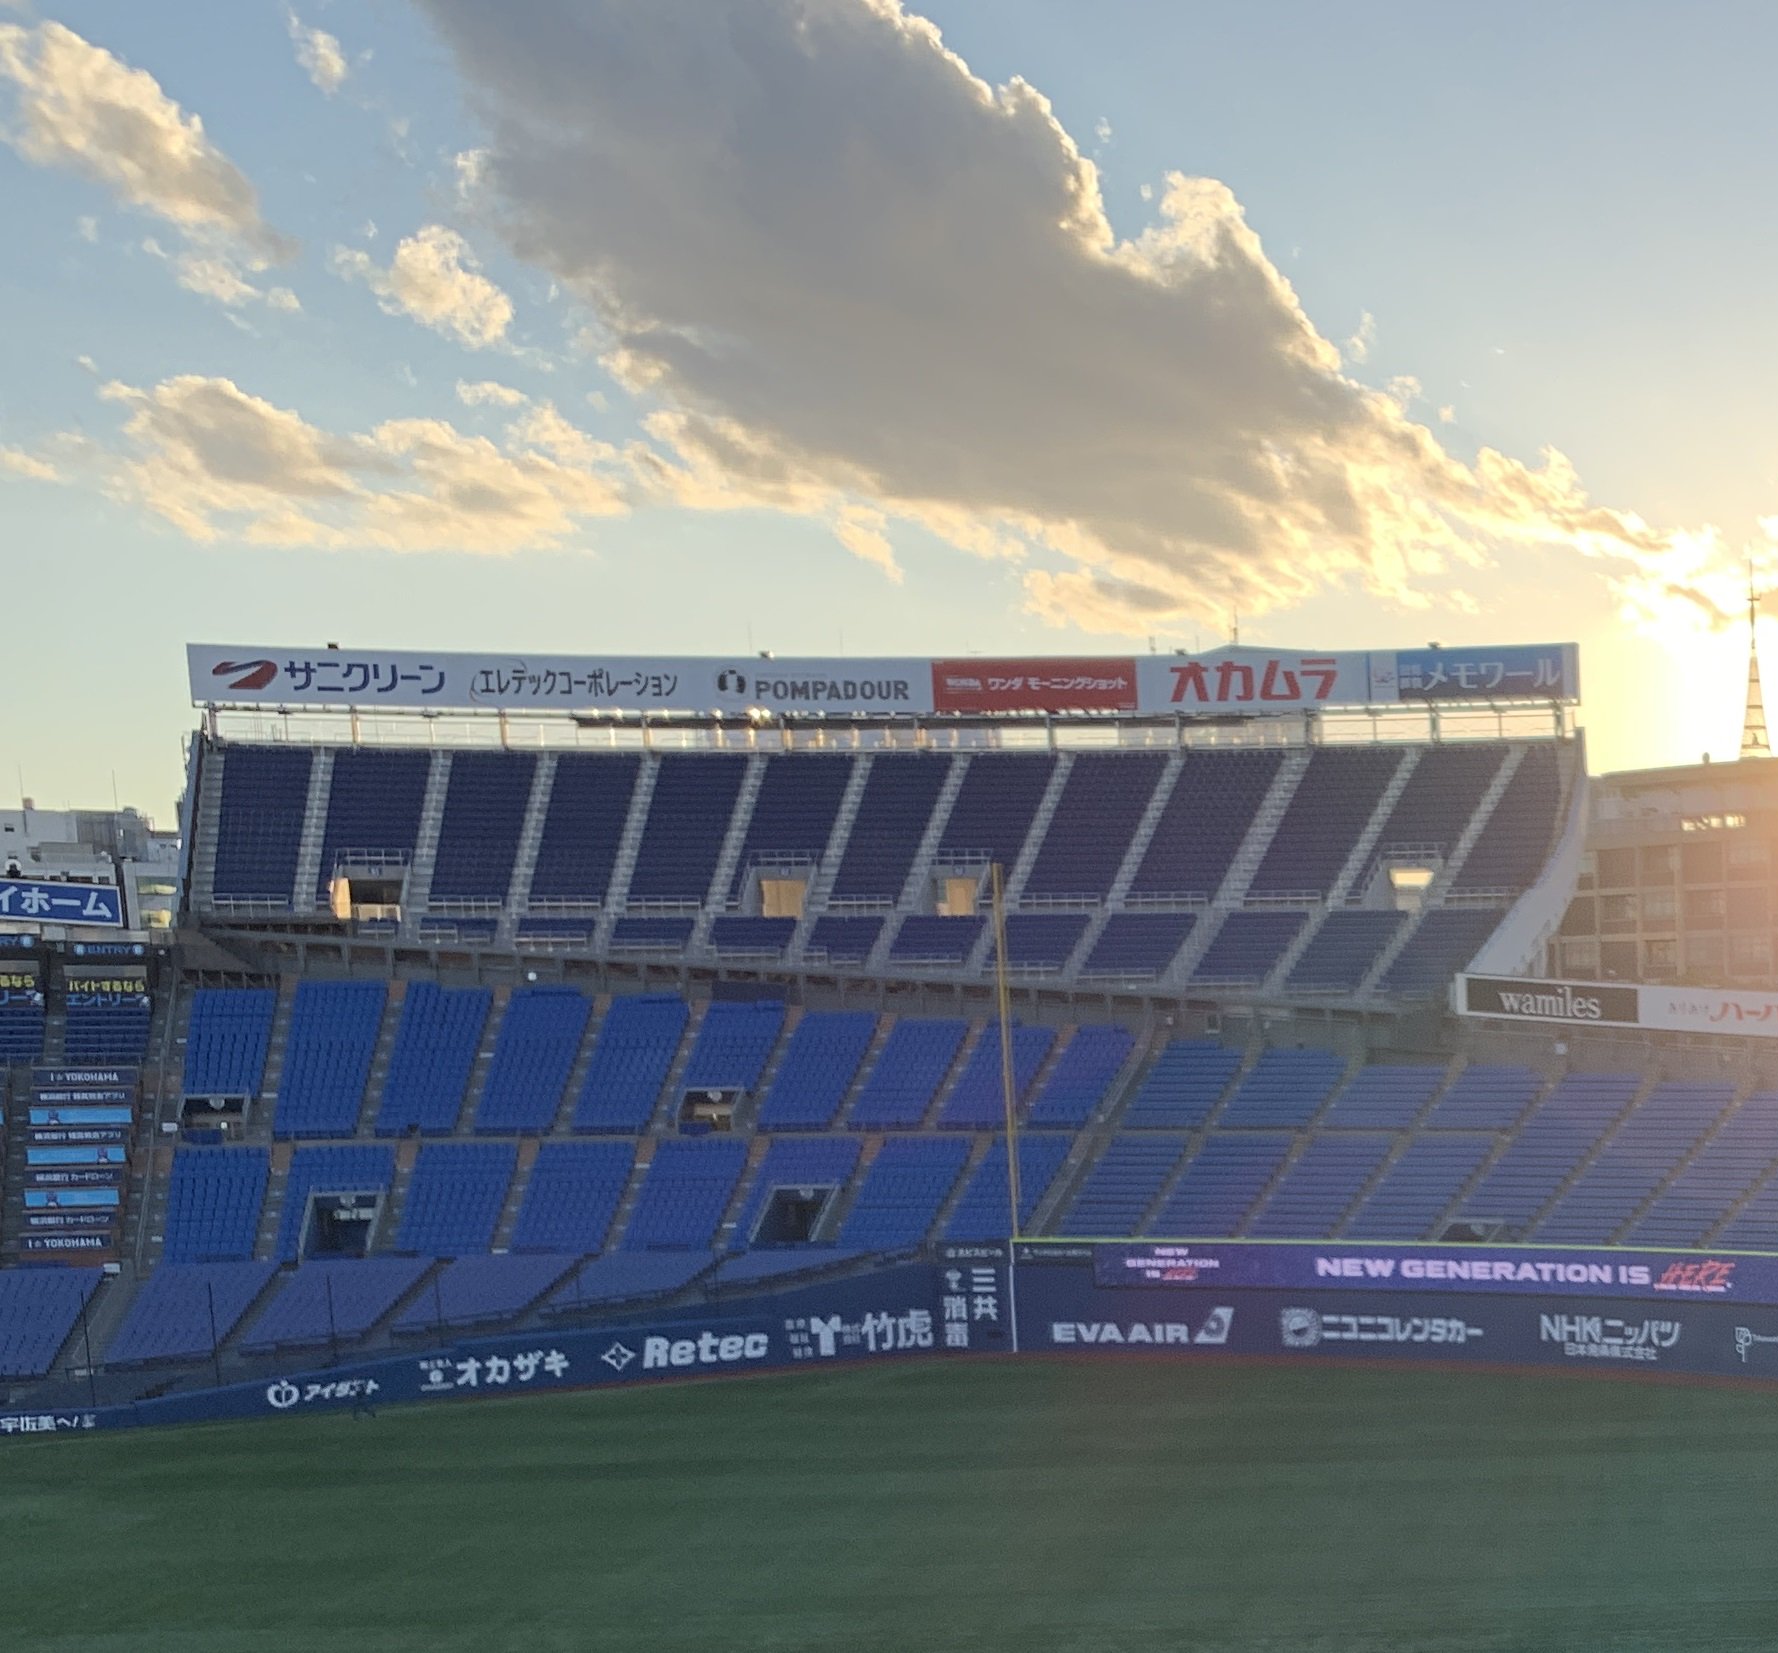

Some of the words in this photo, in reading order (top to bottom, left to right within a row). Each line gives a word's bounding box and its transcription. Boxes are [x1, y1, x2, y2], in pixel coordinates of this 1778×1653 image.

[284, 660, 446, 694] サニクリーン
[755, 679, 909, 701] POMPADOUR
[987, 676, 1024, 690] ワンダ
[1027, 676, 1128, 691] モーニングショット
[1169, 658, 1338, 702] オカムラ
[1424, 658, 1561, 691] メモワール
[87, 945, 131, 955] ENTRY
[1497, 986, 1601, 1019] wamiles
[65, 1073, 119, 1082] YOKOHAMA
[44, 1237, 103, 1248] YOKOHAMA
[1154, 1247, 1190, 1256] NEW
[1125, 1258, 1220, 1268] GENERATION
[1315, 1256, 1395, 1279] NEW
[1401, 1258, 1612, 1284] GENERATION
[1619, 1264, 1652, 1285] IS
[971, 1268, 999, 1321] 三共
[861, 1309, 935, 1352] 竹虎
[1052, 1323, 1125, 1344] EVA
[1127, 1323, 1190, 1344] AIR
[1322, 1313, 1484, 1344] ニコニコレンタカー
[1539, 1314, 1683, 1348] NHKニッパツ
[642, 1331, 769, 1369] Retec
[455, 1348, 571, 1387] オカザキ
